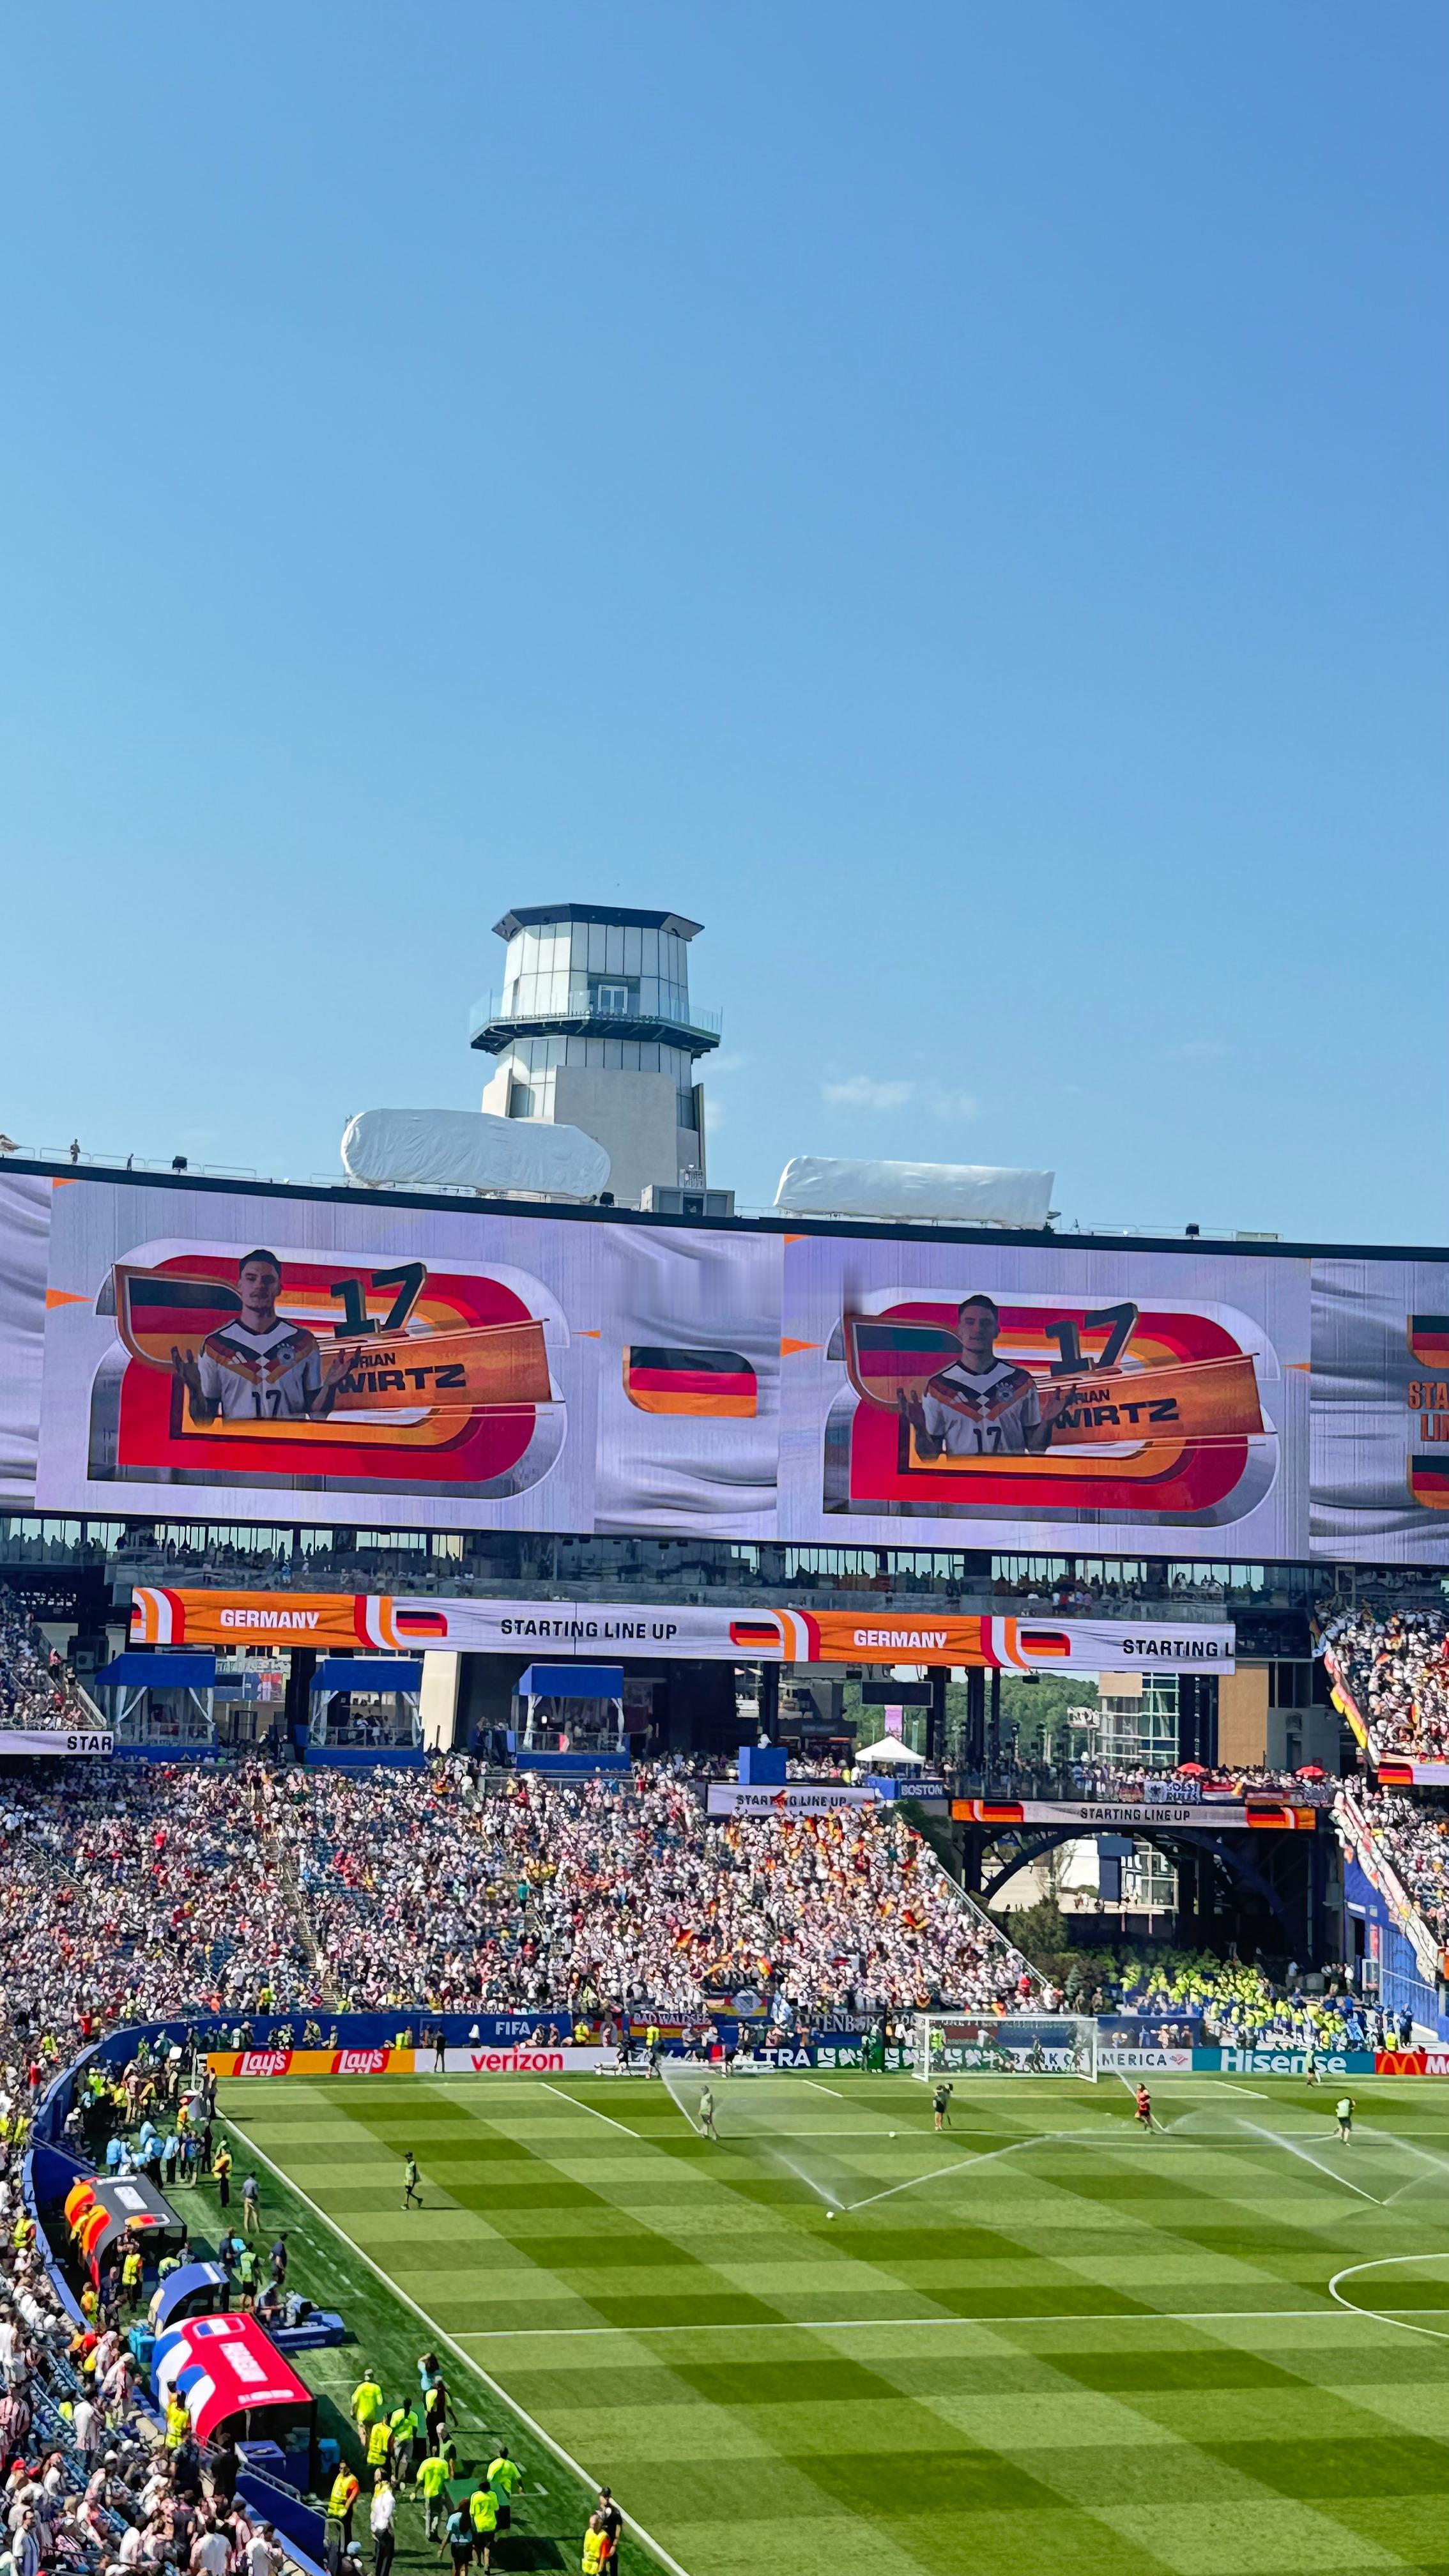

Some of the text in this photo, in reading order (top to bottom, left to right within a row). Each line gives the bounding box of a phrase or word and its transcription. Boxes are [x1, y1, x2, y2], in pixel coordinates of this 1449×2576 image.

[330, 1262, 427, 1338] 17
[1045, 1302, 1139, 1377] 17
[359, 1352, 395, 1369] RIAN
[334, 1363, 466, 1395] WIRTZ
[252, 1389, 282, 1418] 17
[1075, 1389, 1110, 1405] RIAN
[1055, 1398, 1179, 1429] WIRTZ
[973, 1426, 1002, 1454] 17
[220, 1609, 319, 1629] GERMANY
[501, 1619, 677, 1639] STARTING LINE UP
[854, 1630, 947, 1648] GERMANY
[1123, 1639, 1218, 1657] STARTING
[67, 1736, 112, 1751] STAR
[901, 1784, 943, 1796] BOSTON
[736, 1794, 847, 1807] STARG LINE UP
[1080, 1807, 1190, 1821] STARTING LINE UP
[495, 2021, 531, 2035] FIFA
[240, 2050, 286, 2076] Lay's
[337, 2049, 384, 2074] Lay's
[470, 2050, 564, 2072] verizon
[1097, 2052, 1167, 2067] MERICA
[1220, 2048, 1347, 2074] Hisense
[1425, 2055, 1449, 2075] M
